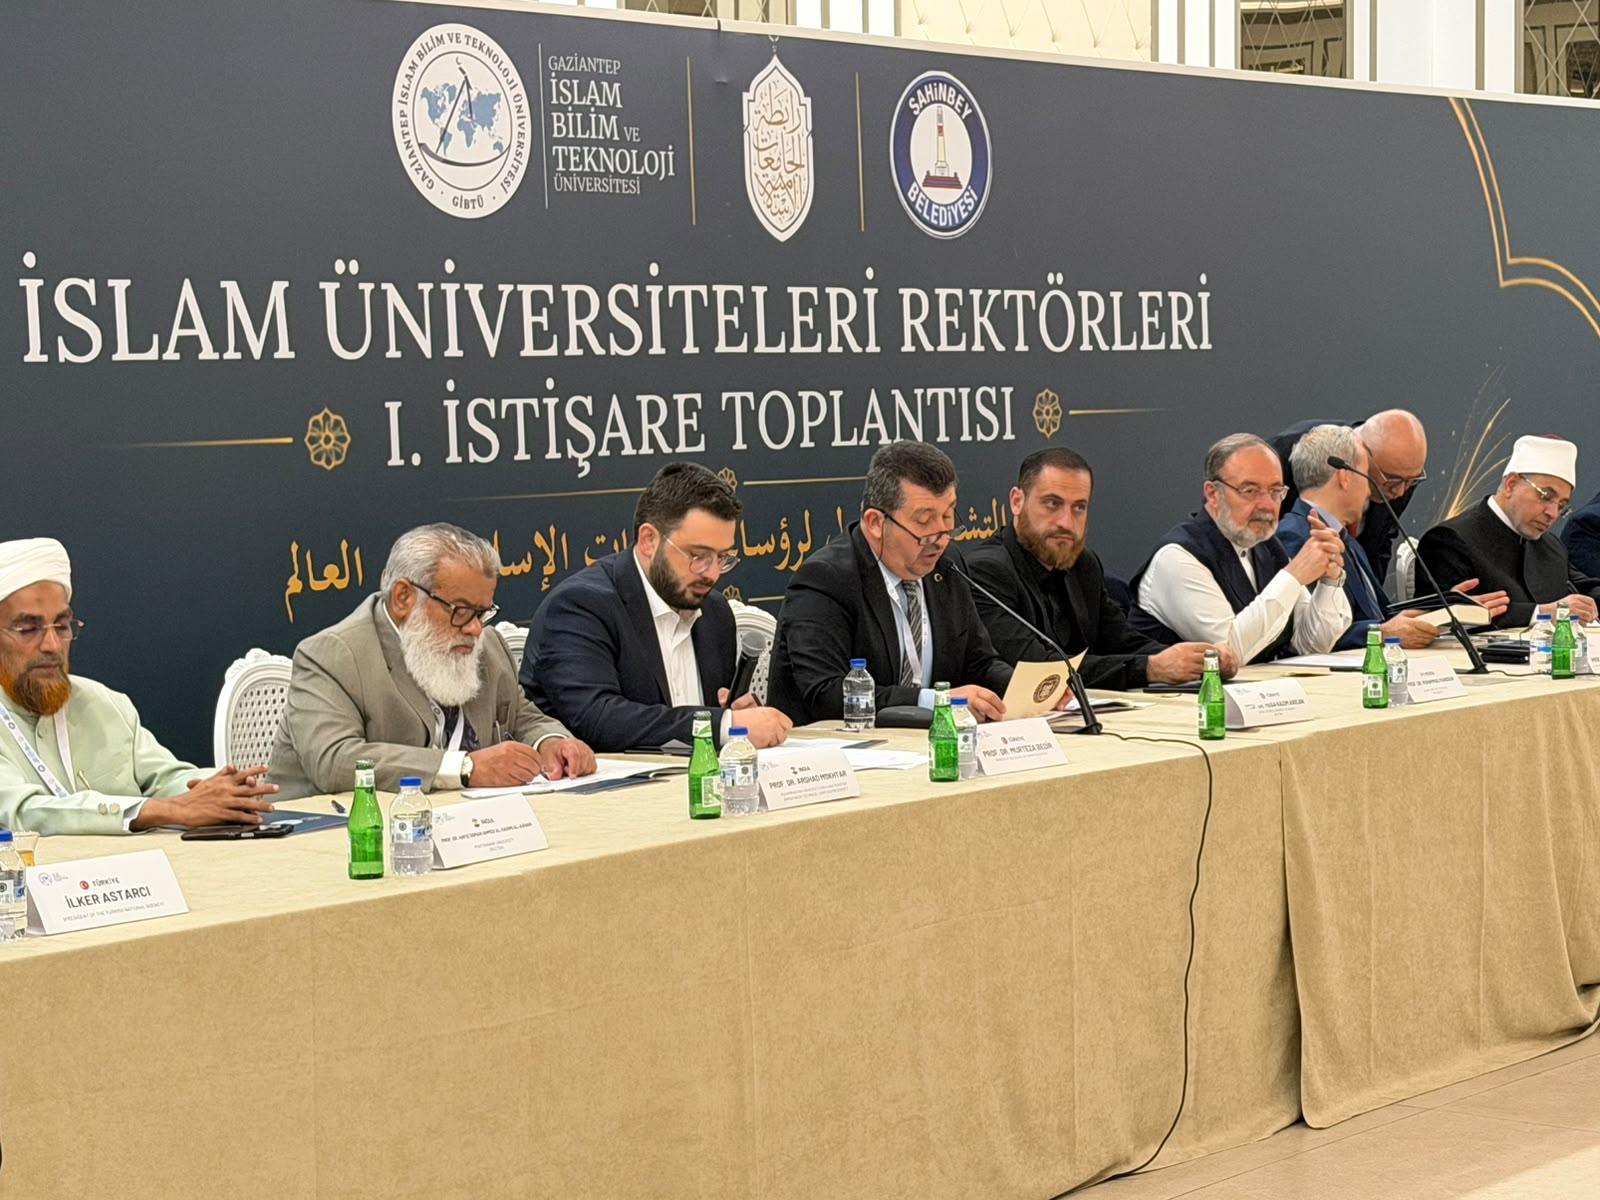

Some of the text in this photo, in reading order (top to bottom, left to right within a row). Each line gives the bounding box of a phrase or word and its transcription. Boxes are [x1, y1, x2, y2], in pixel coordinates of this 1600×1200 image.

[400, 60, 418, 106] İSLAM
[416, 34, 446, 62] BİLİM
[447, 32, 462, 44] VE
[549, 52, 621, 75] GAZİANTEP
[550, 75, 623, 108] İSLAM
[551, 105, 641, 142] BİLİM VE
[552, 144, 675, 182] TEKNOLOJİ
[553, 173, 641, 195] ÜNİVERSİTESİ
[19, 252, 1213, 363] İSLAM ÜNİVERSİTELERİ REKTÖRLERİ
[385, 378, 1016, 479] I. İSTİŞARE TOPLANTISI
[285, 539, 363, 624] العالم
[65, 886, 152, 909] İLKER ASTARCI
[92, 877, 120, 887] TÜRKİYE
